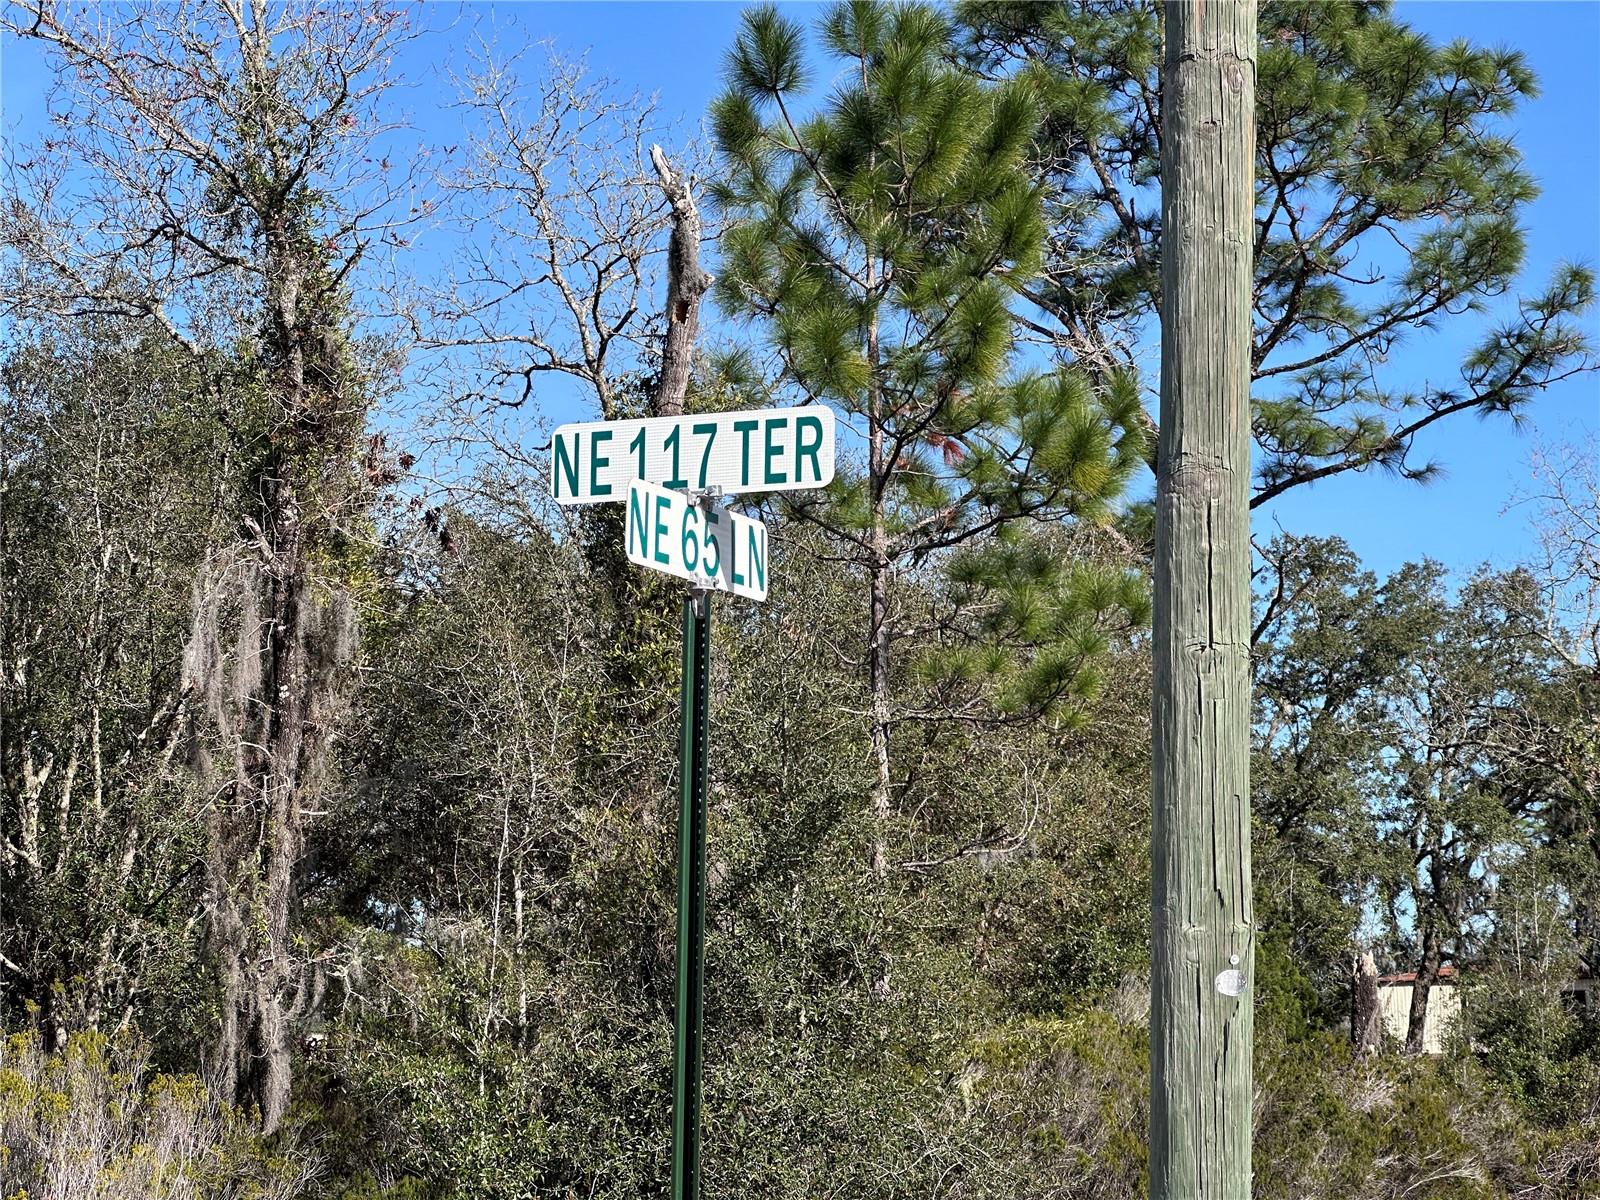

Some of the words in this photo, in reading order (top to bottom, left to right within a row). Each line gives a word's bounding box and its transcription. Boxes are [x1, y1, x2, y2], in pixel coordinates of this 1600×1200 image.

[554, 430, 613, 498] NE
[629, 423, 718, 490] 117
[733, 415, 823, 487] TER
[629, 487, 672, 565] NE
[681, 505, 720, 577] 65
[731, 519, 764, 592] LN
